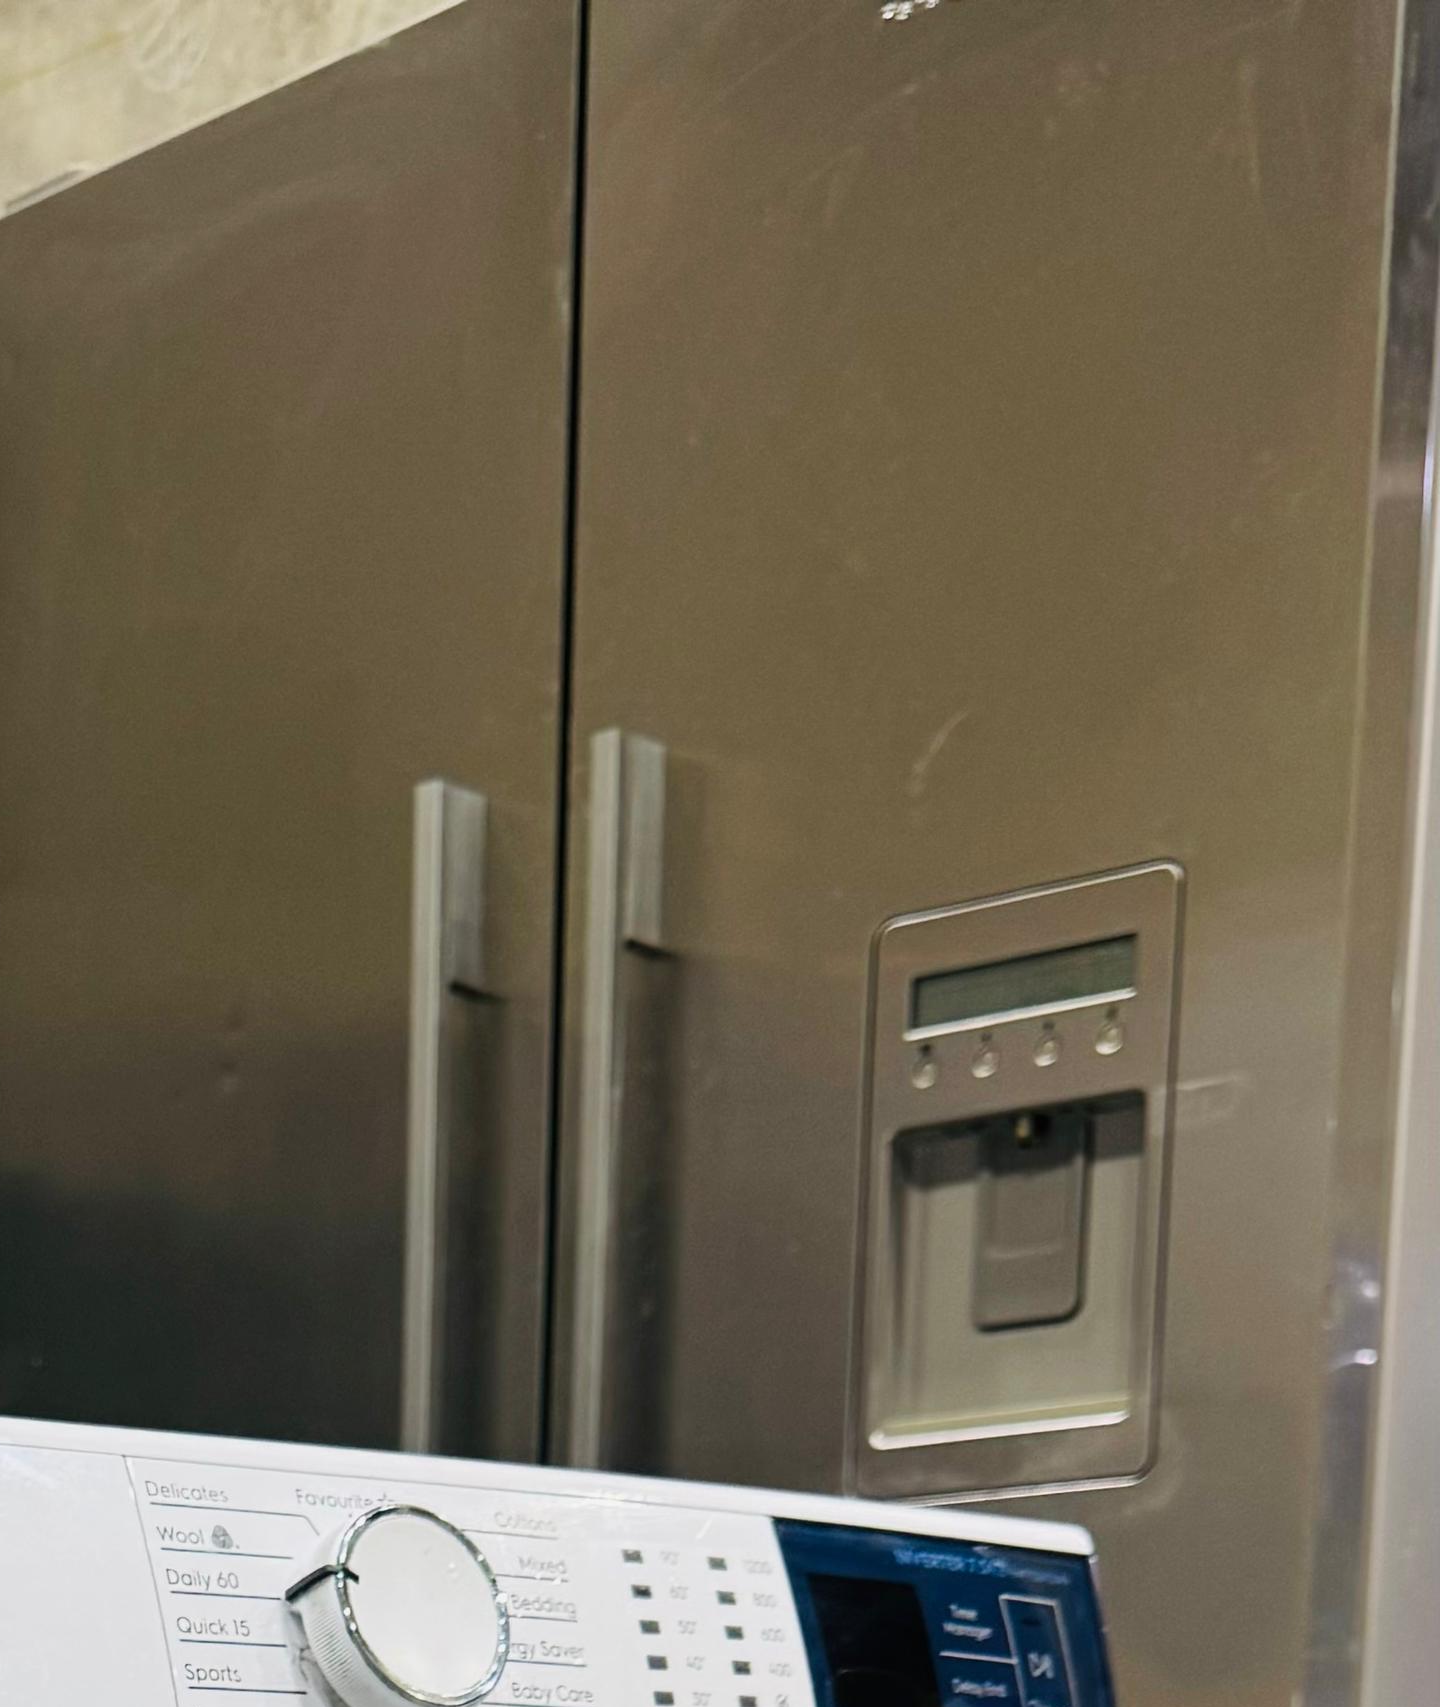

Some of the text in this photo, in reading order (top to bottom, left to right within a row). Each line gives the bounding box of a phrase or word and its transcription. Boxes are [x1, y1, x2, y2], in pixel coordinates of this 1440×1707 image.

[145, 1480, 228, 1502] Delicates
[295, 1489, 374, 1509] Favourite
[157, 1525, 204, 1545] Wool
[517, 1556, 568, 1575] Mixed
[166, 1568, 240, 1590] Daily 60
[510, 1594, 578, 1618] Bedding
[176, 1616, 250, 1637] Quick 15
[539, 1640, 585, 1659] Saver
[184, 1663, 242, 1683] Sports
[511, 1682, 594, 1705] Baby Care
